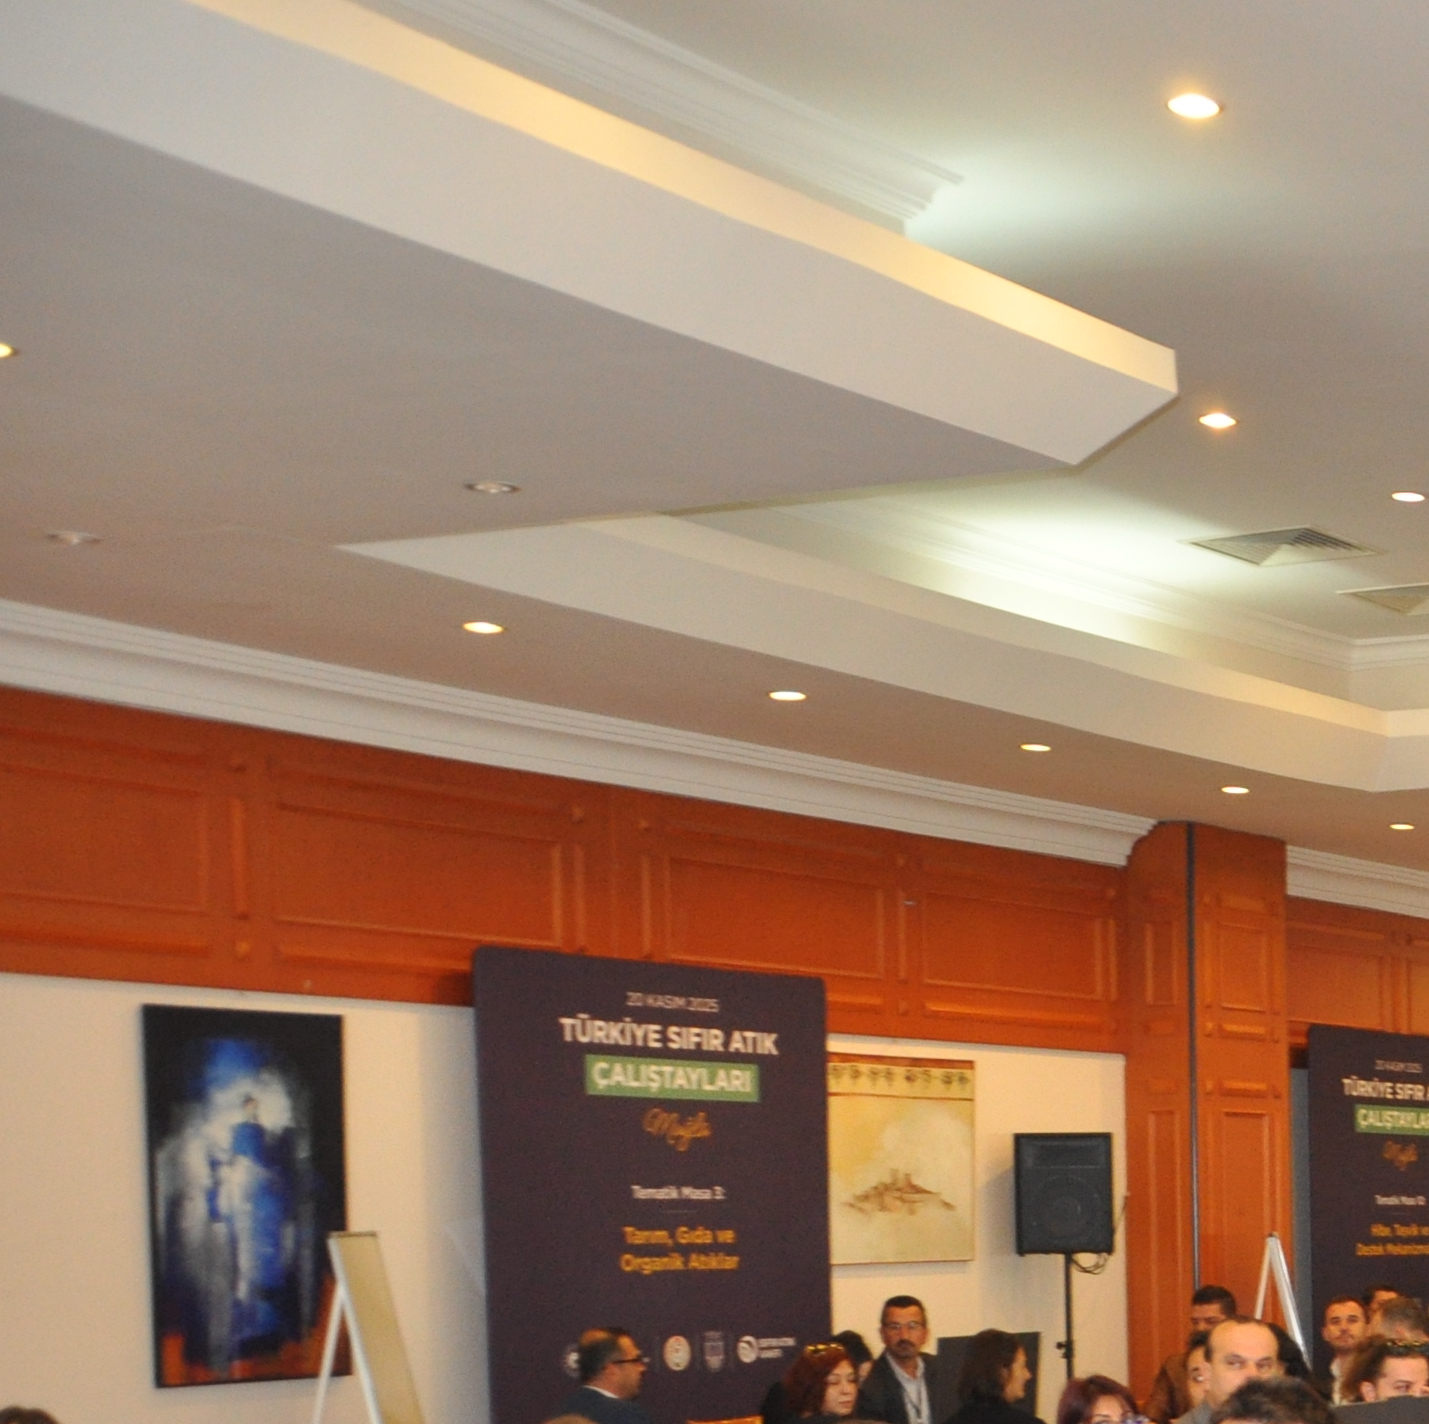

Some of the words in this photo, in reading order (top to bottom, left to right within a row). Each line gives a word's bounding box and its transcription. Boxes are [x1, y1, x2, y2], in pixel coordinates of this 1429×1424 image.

[558, 1013, 663, 1048] TÜRKİYE
[666, 1025, 725, 1051] SIFIR
[728, 1030, 779, 1055] ATIK
[593, 1062, 751, 1093] ÇALIŞTAYLARI
[620, 1252, 684, 1275] Organik
